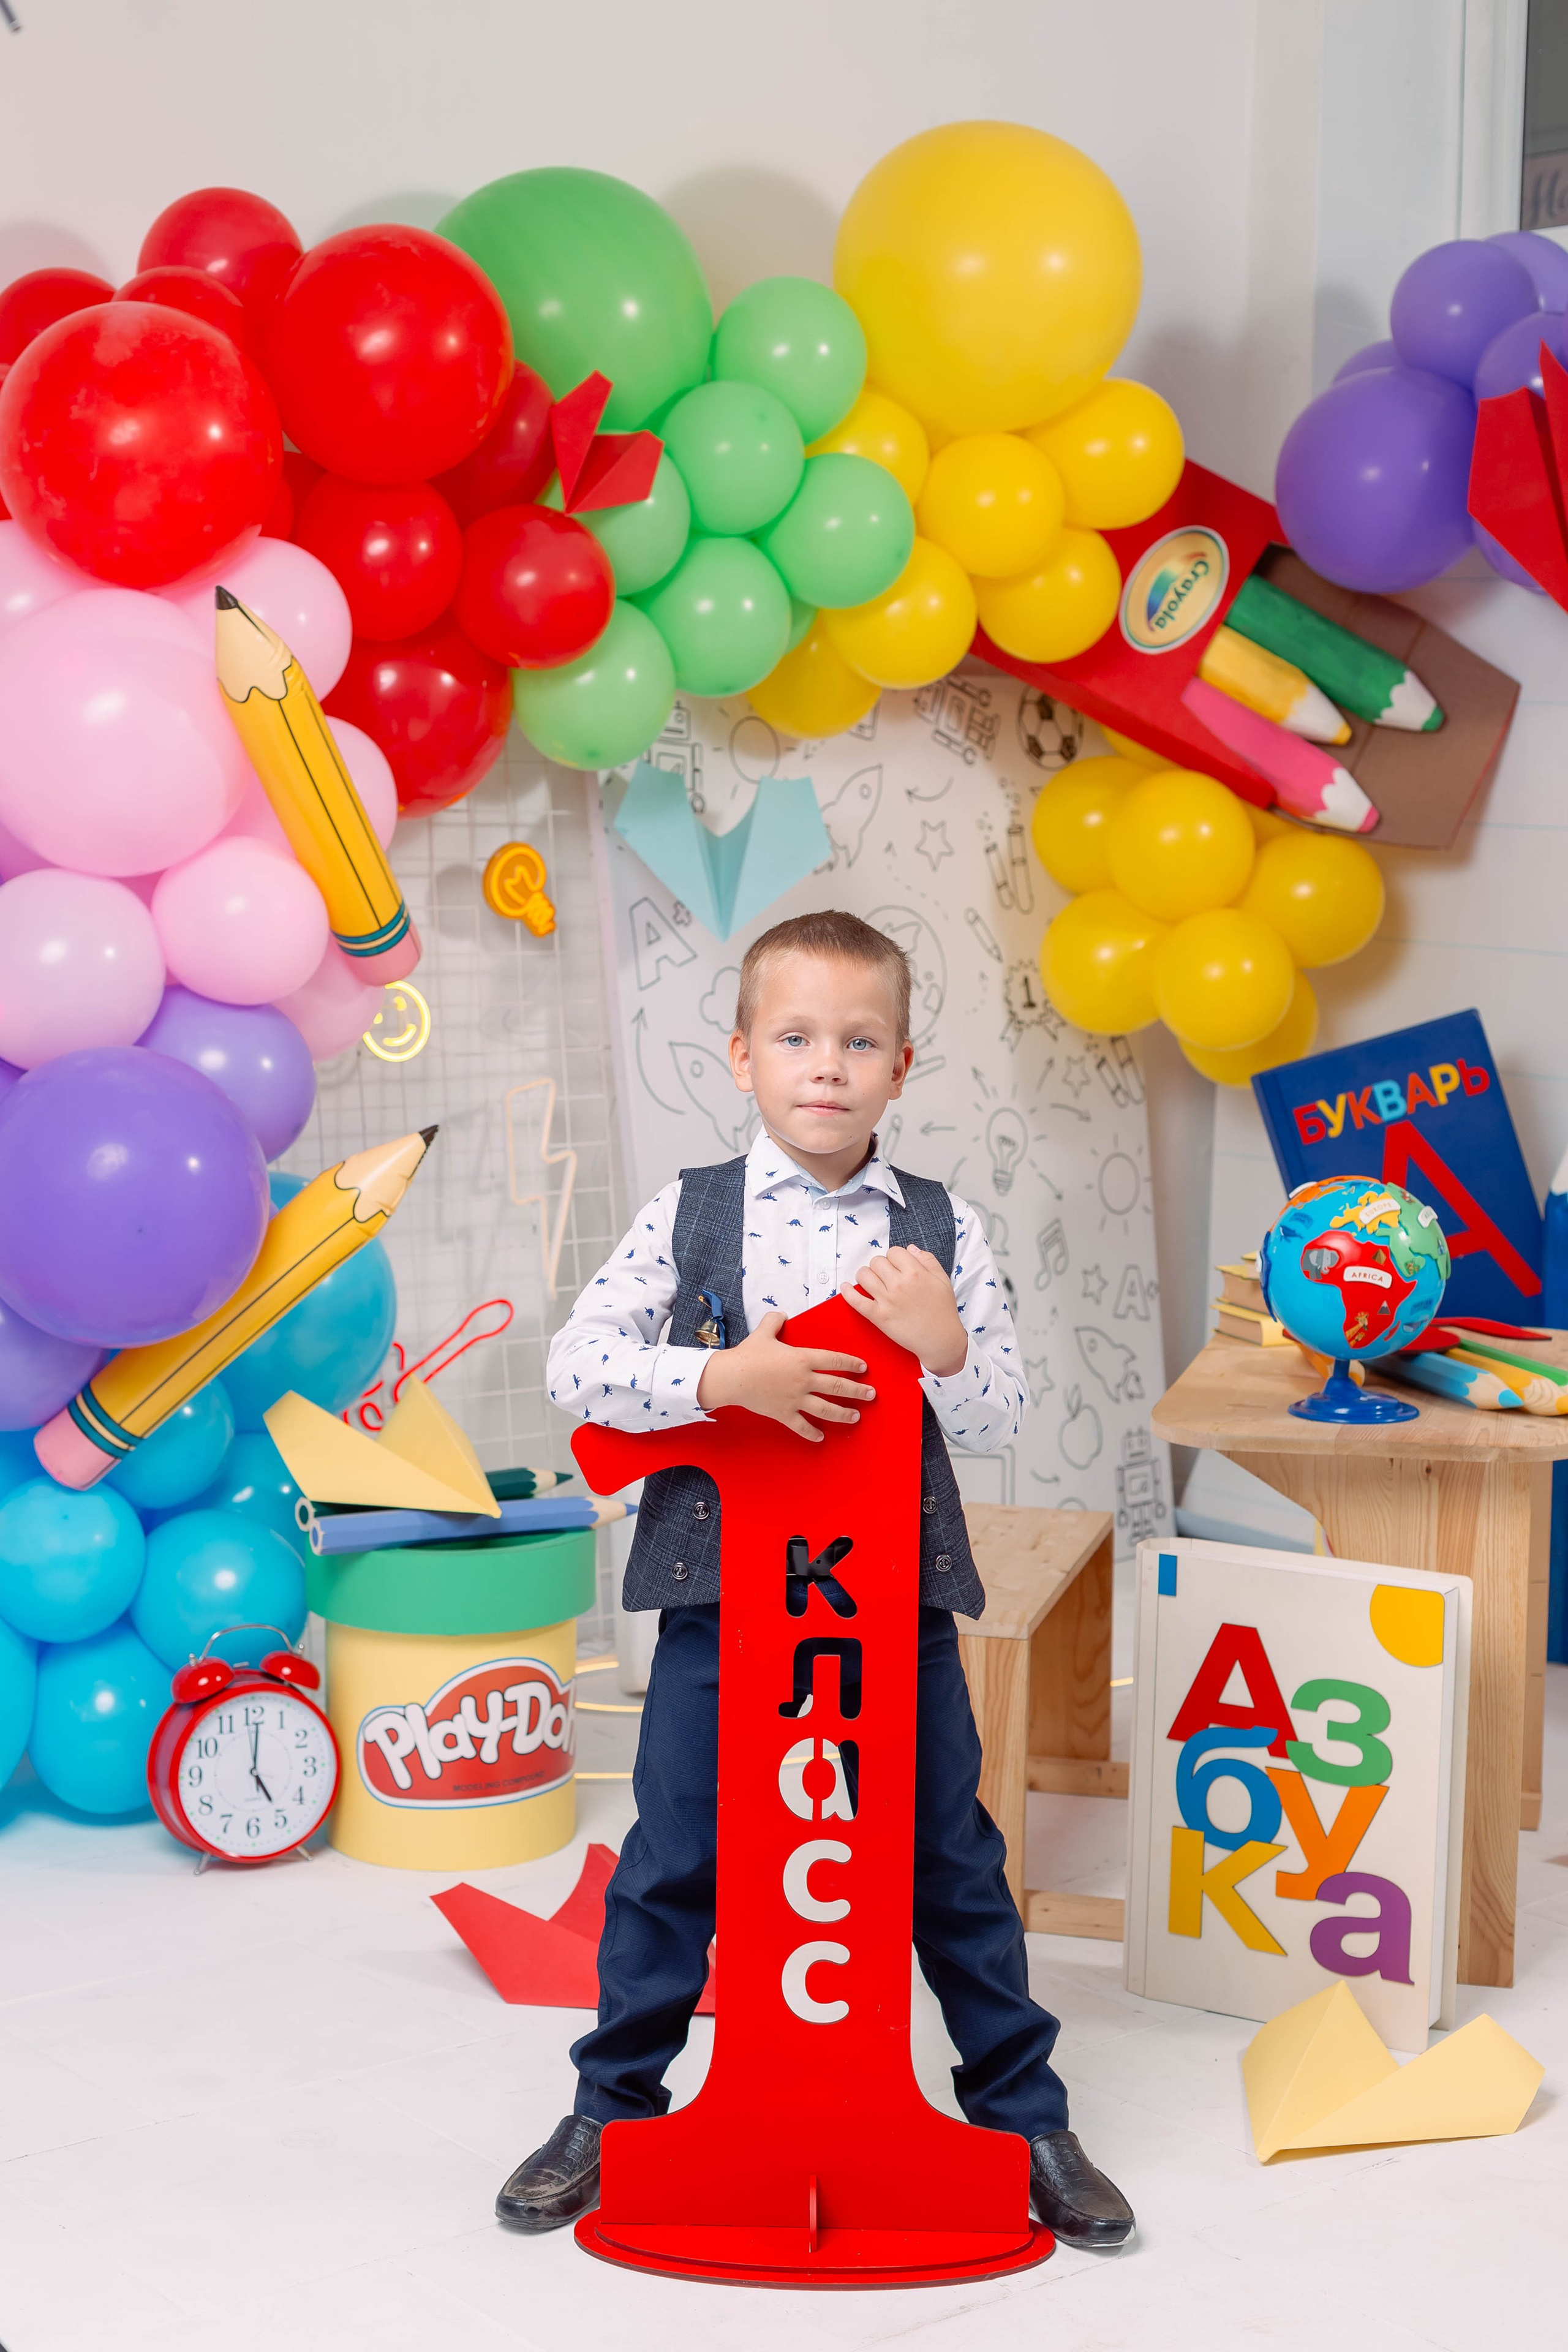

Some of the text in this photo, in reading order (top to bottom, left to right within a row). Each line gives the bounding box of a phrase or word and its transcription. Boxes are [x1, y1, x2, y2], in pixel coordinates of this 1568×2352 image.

[1155, 560, 1208, 628] Crayola
[1020, 976, 1036, 1008] 1
[1293, 1059, 1490, 1145] БУКВАРЬ
[1352, 1272, 1383, 1283] AFRICA
[218, 1716, 234, 1735] 11
[244, 1706, 265, 1727] 12
[277, 1711, 285, 1730] 1
[197, 1738, 218, 1758] 10
[295, 1730, 307, 1749] 2
[189, 1765, 203, 1787] 9
[304, 1756, 317, 1777] 3
[292, 1785, 305, 1805] 4
[198, 1795, 213, 1816] 8
[220, 1814, 233, 1833] 7
[246, 1817, 261, 1839] 6
[274, 1809, 287, 1828] 5
